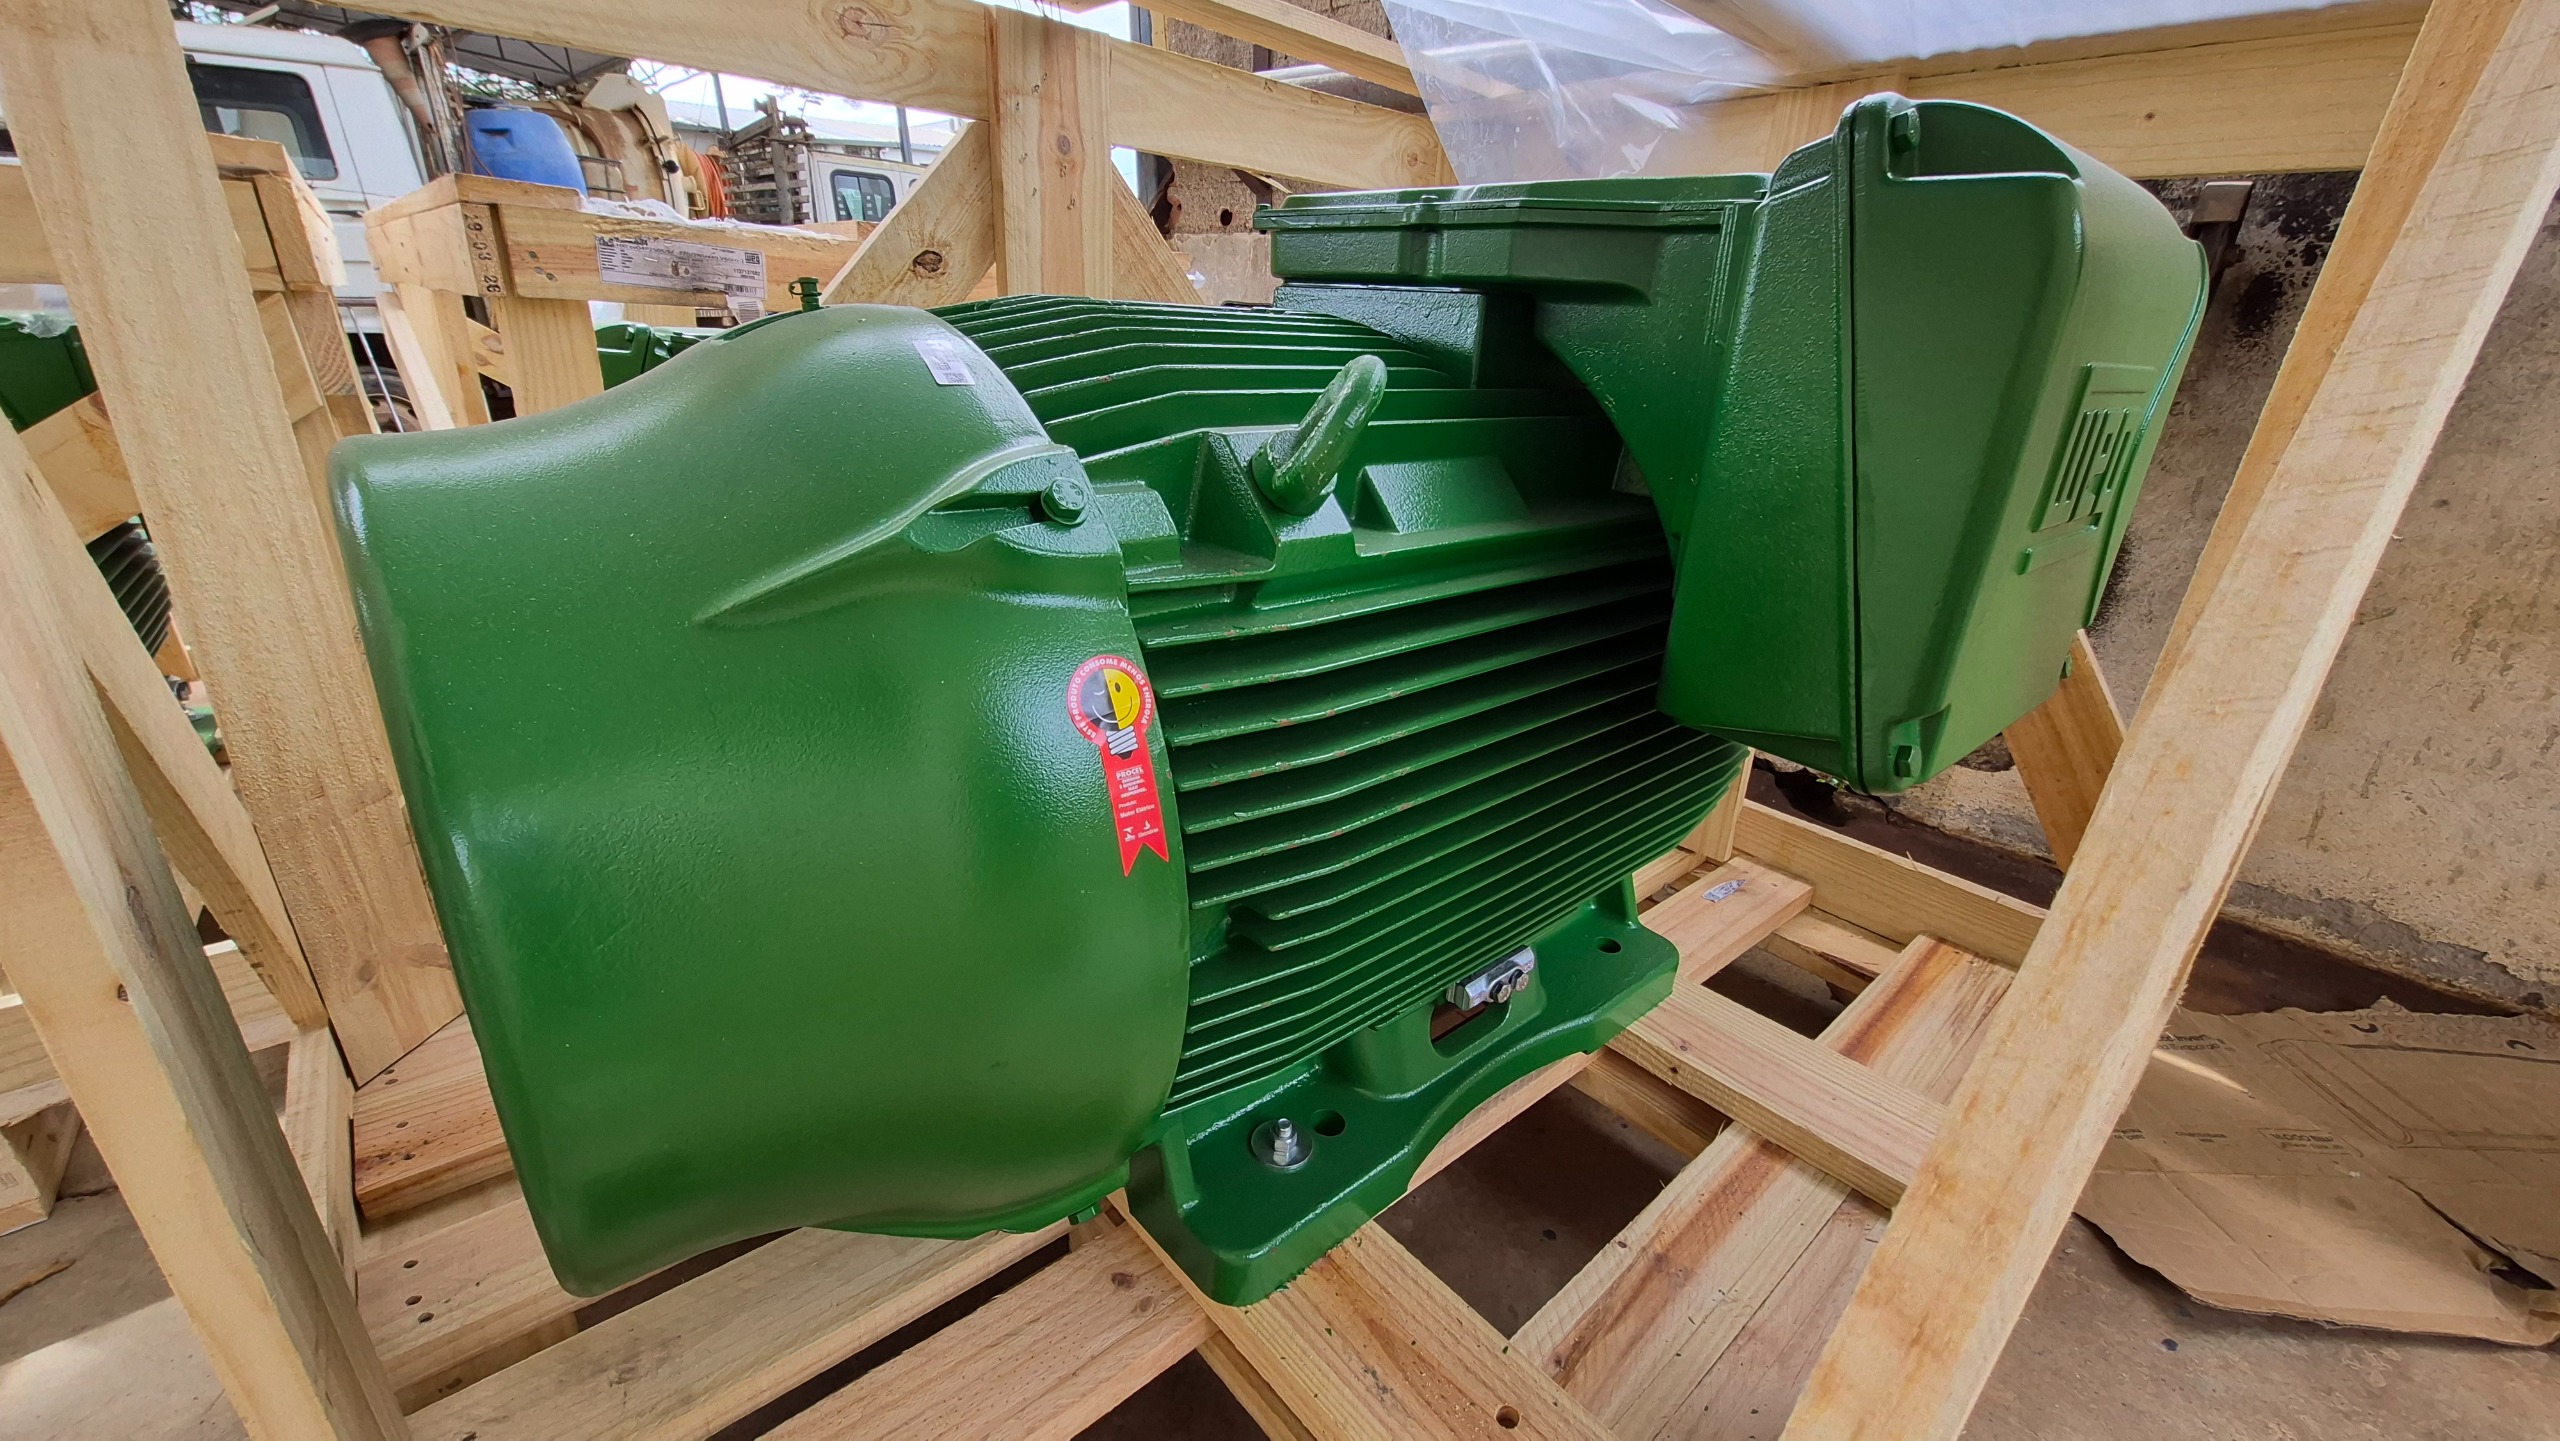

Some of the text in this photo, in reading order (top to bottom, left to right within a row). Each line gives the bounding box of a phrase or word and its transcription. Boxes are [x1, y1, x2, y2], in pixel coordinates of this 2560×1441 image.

[1070, 658, 1151, 739] ESTE PRODUTO CONSOME MENOS ENERGIA
[1116, 766, 1144, 781] PROCEL
[1120, 810, 1135, 819] Motor
